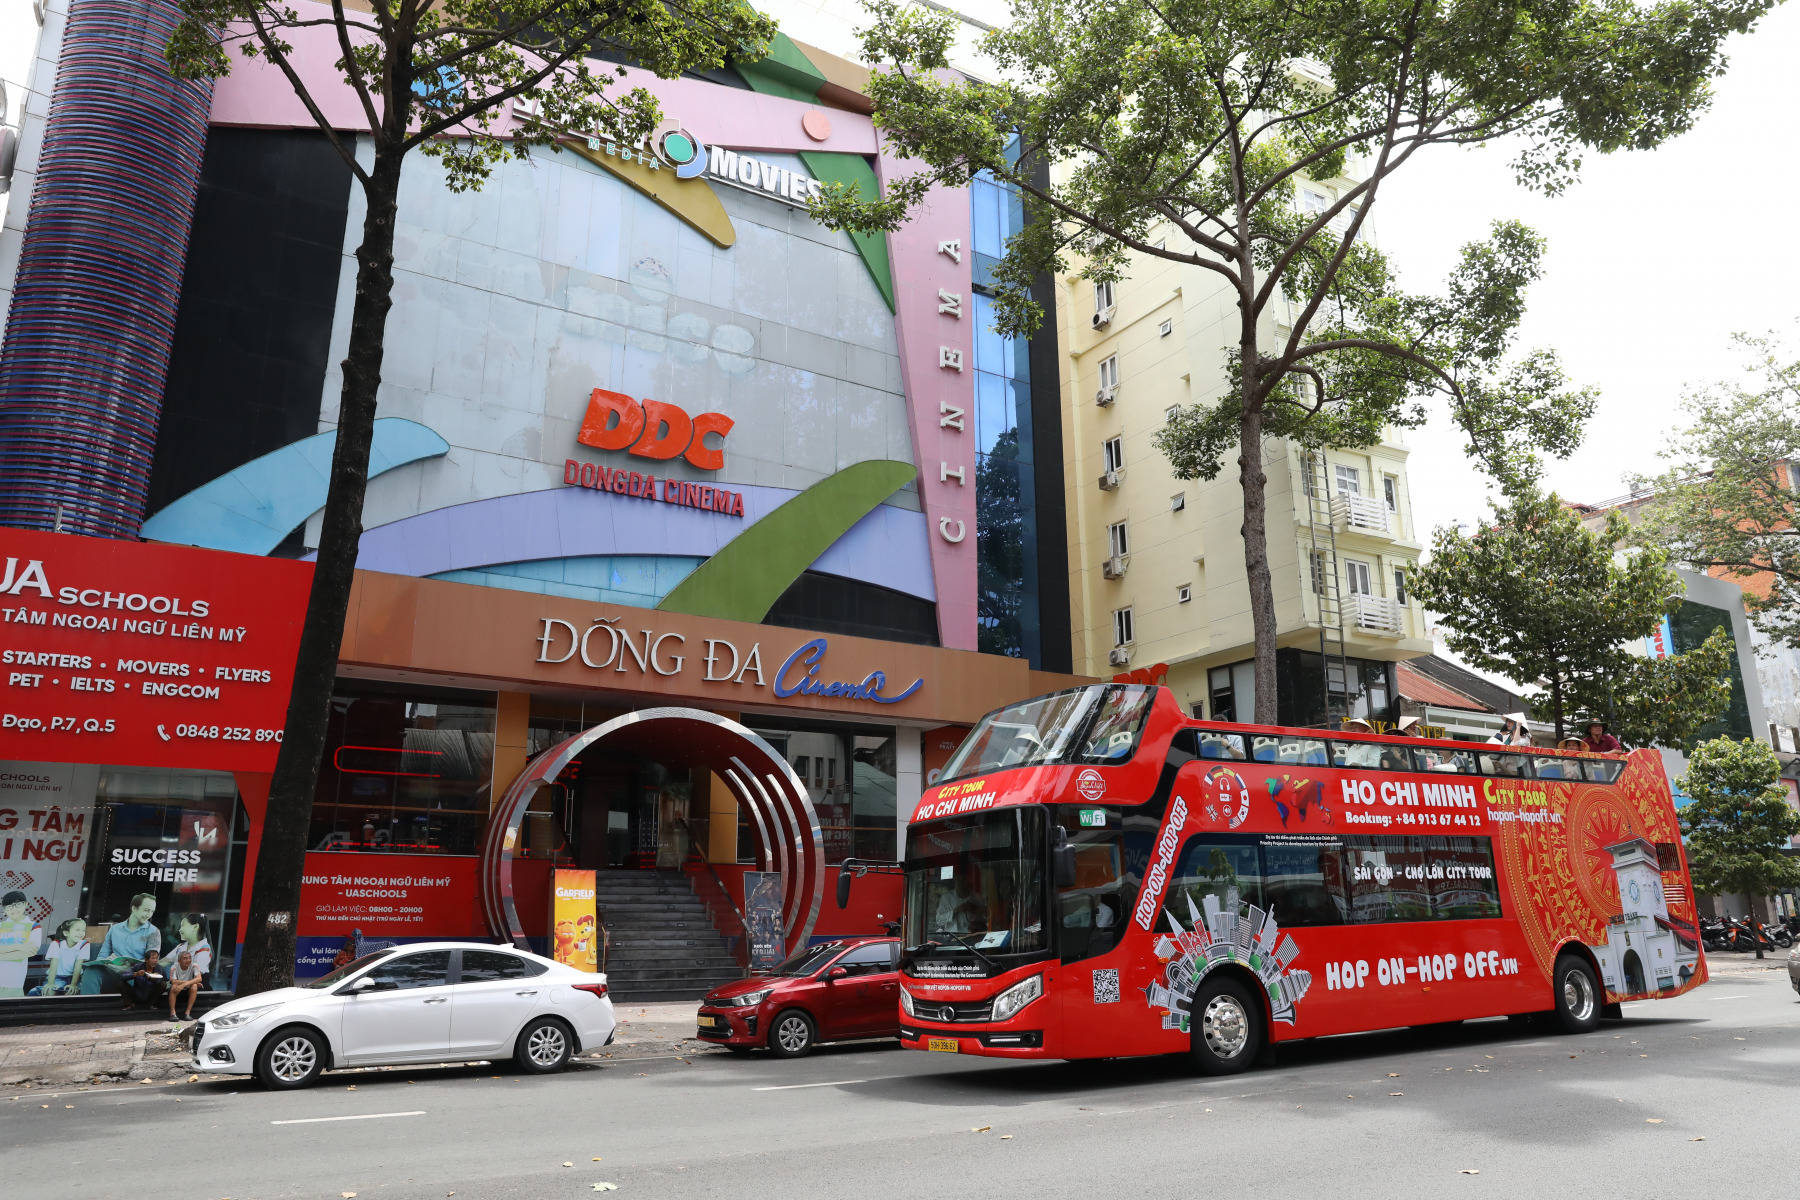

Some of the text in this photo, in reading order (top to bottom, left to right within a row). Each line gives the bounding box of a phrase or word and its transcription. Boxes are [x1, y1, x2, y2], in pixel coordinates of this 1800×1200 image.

[588, 137, 659, 170] MEDIA
[710, 145, 822, 205] MOVIES
[938, 239, 966, 543] CINEMA
[577, 388, 735, 471] DDC
[564, 459, 744, 517] DONGDA CINEMA
[58, 587, 210, 617] SCHOOLS
[2, 607, 246, 642] TÂM NGOẠI NGỮ LIÊN MỸ
[536, 616, 766, 686] ĐỐNG ĐA
[2, 650, 271, 683] STARTERS MOVERS FLYERS
[774, 638, 924, 704] Cinema
[9, 672, 220, 699] PET IELTS ENGCOM
[84, 719, 115, 732] Q.5
[176, 724, 284, 742] 0848 252 890
[0, 774, 50, 783] CHOOLS
[938, 780, 985, 799] CITY TOUR
[917, 791, 996, 820] HO CHI MINH
[1341, 779, 1477, 808] HO CHI MINH
[1518, 790, 1547, 806] TOUR
[28, 806, 84, 834] TÂM
[1345, 812, 1481, 827] Booking: +84 913 67 44 12
[1487, 807, 1562, 826] hopon-hopoff.vn
[22, 836, 84, 862] NGỮ
[110, 848, 201, 864] SUCCESS
[110, 865, 198, 882] starts HERE
[301, 875, 451, 888] RUNG TÂM NGOẠI NGỮ LIÊN MỸ
[1354, 864, 1370, 880] SÀI
[1374, 864, 1393, 880] GÒN
[1405, 866, 1424, 882] CHỢ
[1426, 864, 1444, 879] LỚN
[1447, 866, 1466, 879] CITY
[1469, 866, 1492, 879] TOUR
[345, 889, 407, 898] UASCHOOLS
[556, 887, 594, 897] GARFIELD
[268, 913, 287, 923] 482
[316, 904, 331, 912] GIỜ
[332, 904, 347, 912] LÀM
[1325, 959, 1369, 991] HOP
[1464, 950, 1518, 978] OFF.VN
